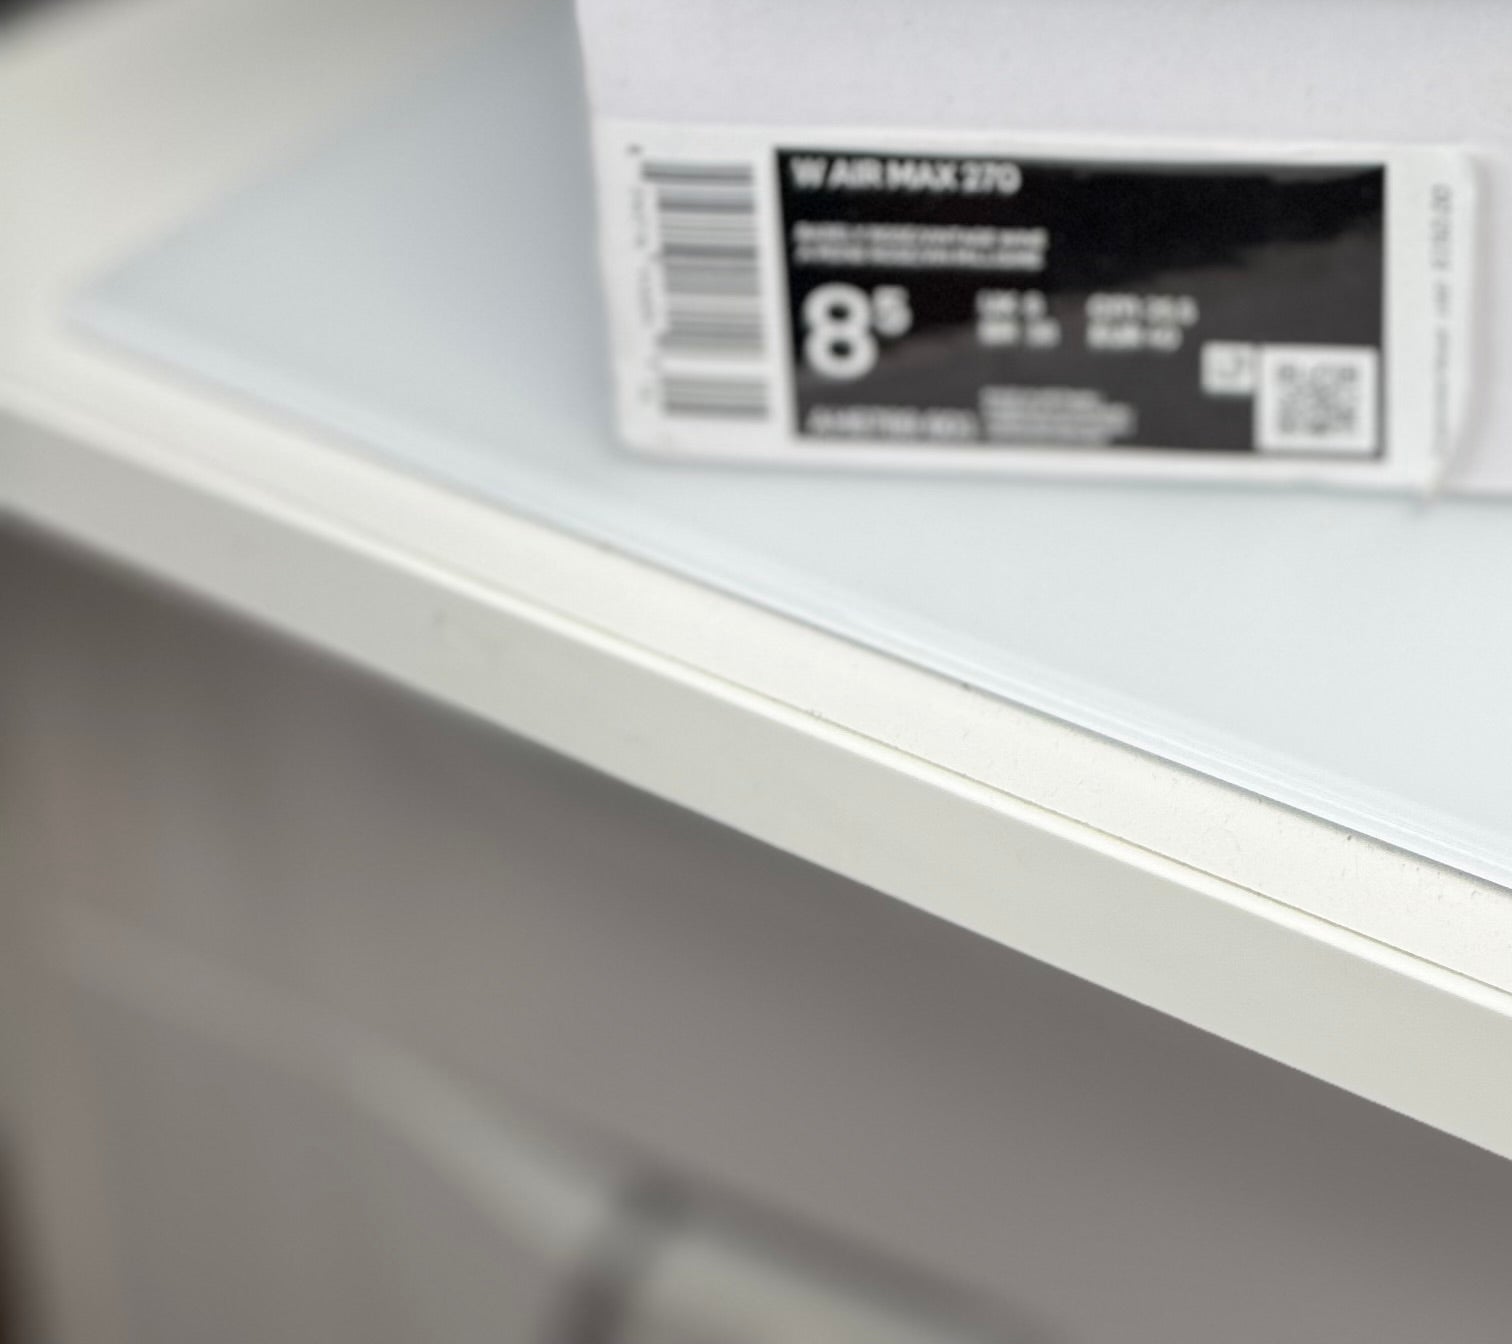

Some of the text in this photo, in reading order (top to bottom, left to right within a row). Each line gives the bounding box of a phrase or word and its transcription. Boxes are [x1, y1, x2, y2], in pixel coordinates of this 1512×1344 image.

[827, 157, 884, 193] AIR
[885, 158, 960, 195] MAX
[957, 160, 1023, 197] 270
